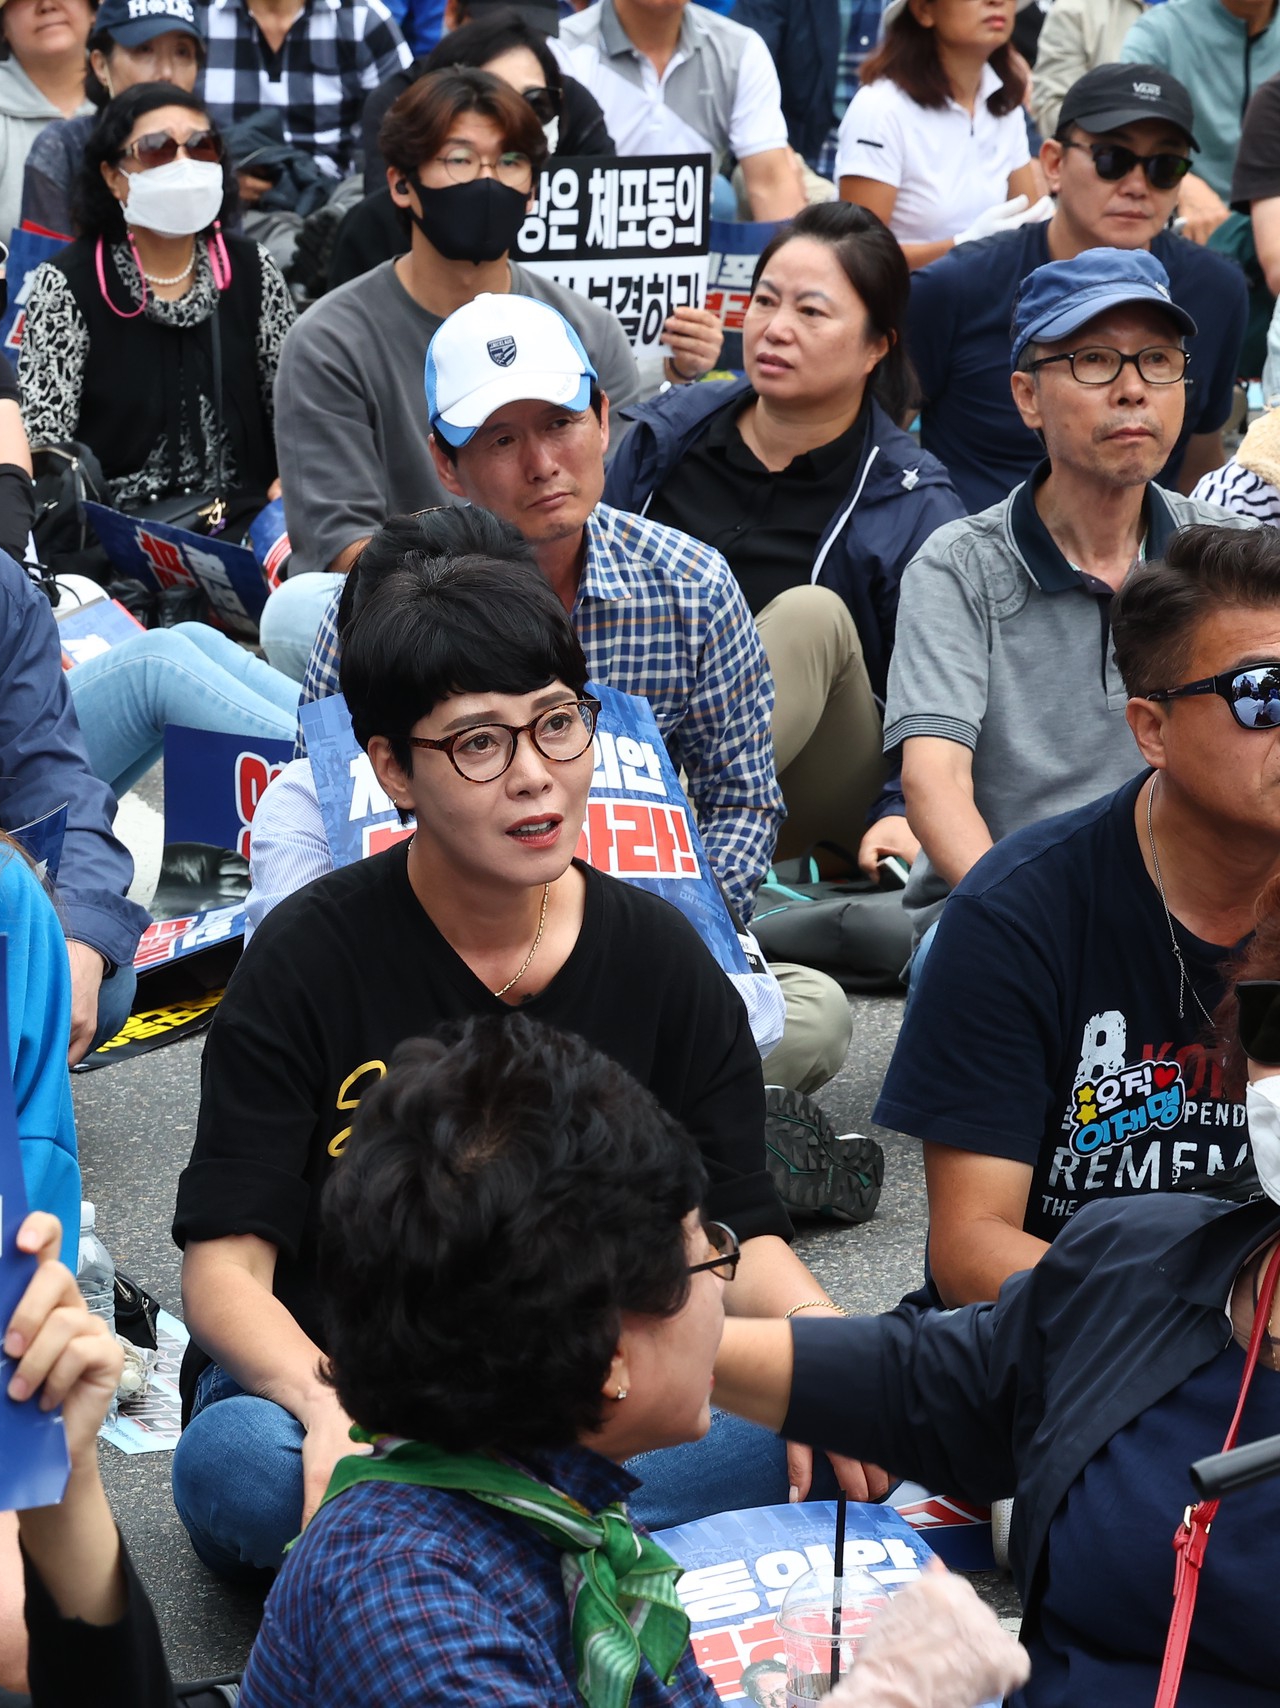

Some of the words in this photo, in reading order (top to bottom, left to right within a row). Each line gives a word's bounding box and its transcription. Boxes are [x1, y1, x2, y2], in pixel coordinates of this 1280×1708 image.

[585, 165, 704, 250] 체포동의
[1075, 1085, 1181, 1153] 이재명
[1095, 1068, 1153, 1114] 오직
[1042, 1194, 1078, 1217] THE
